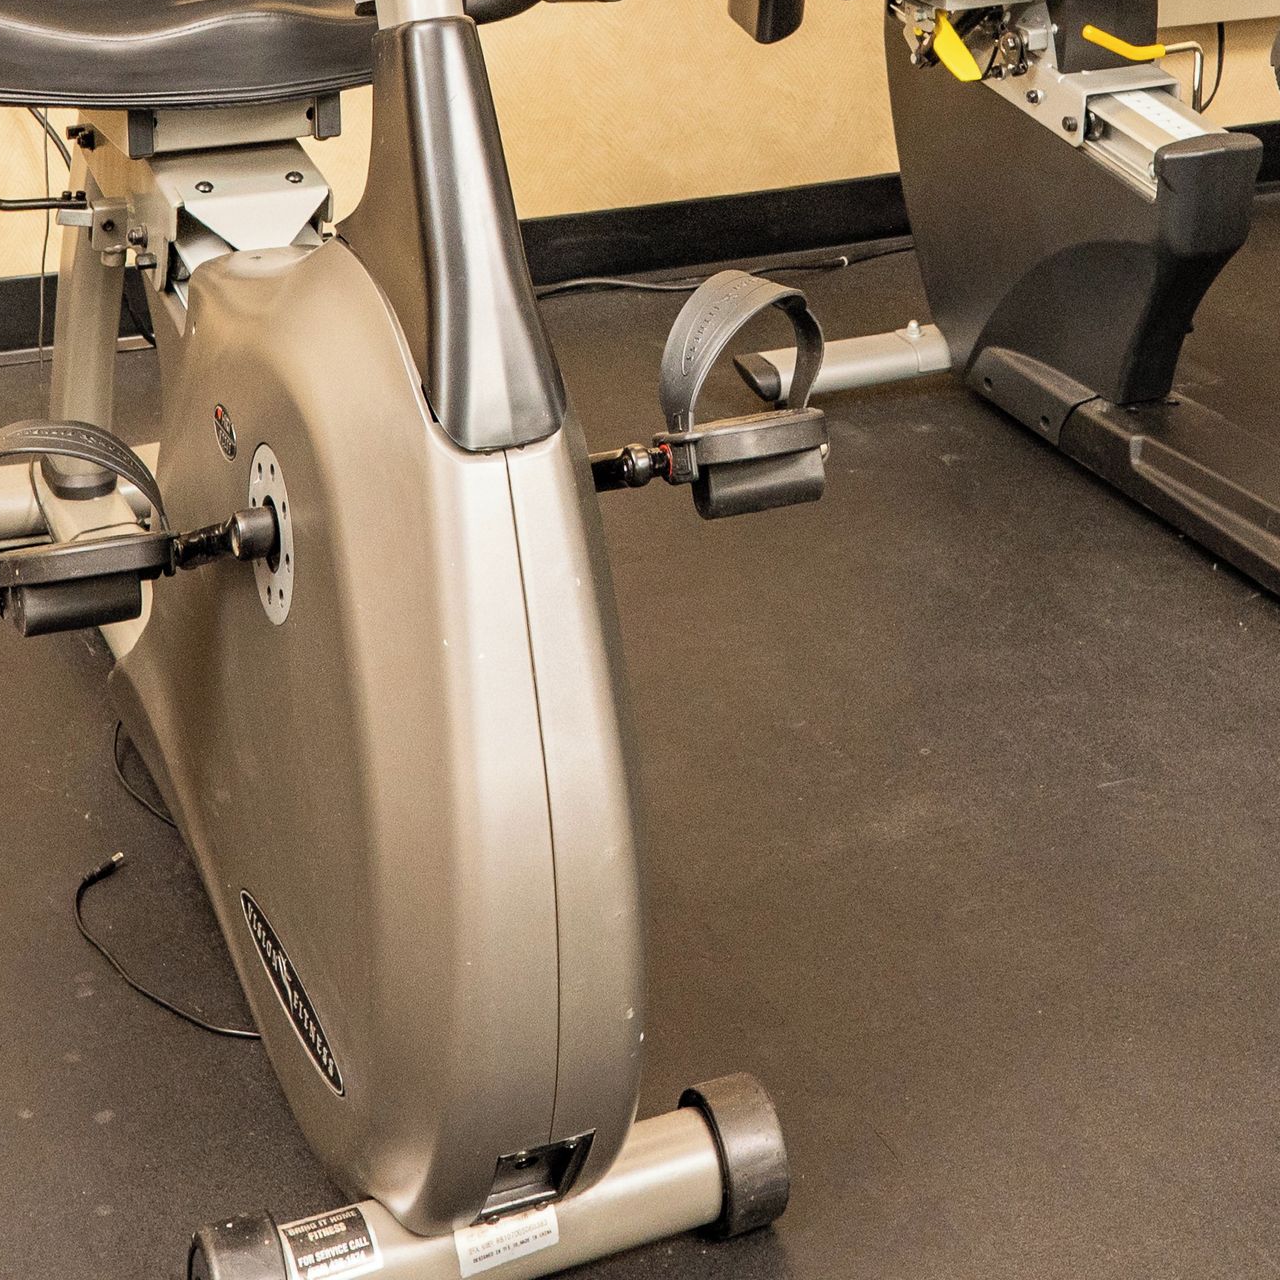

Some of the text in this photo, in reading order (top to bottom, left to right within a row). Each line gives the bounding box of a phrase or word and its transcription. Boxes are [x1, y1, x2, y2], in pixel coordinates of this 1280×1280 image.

[293, 990, 334, 1077] FITNESS
[287, 1210, 357, 1236] BRING IT HOME
[308, 1222, 347, 1241] FITNESS
[297, 1253, 315, 1267] FOR
[315, 1242, 349, 1261] SERVICE
[349, 1236, 369, 1250] CALL
